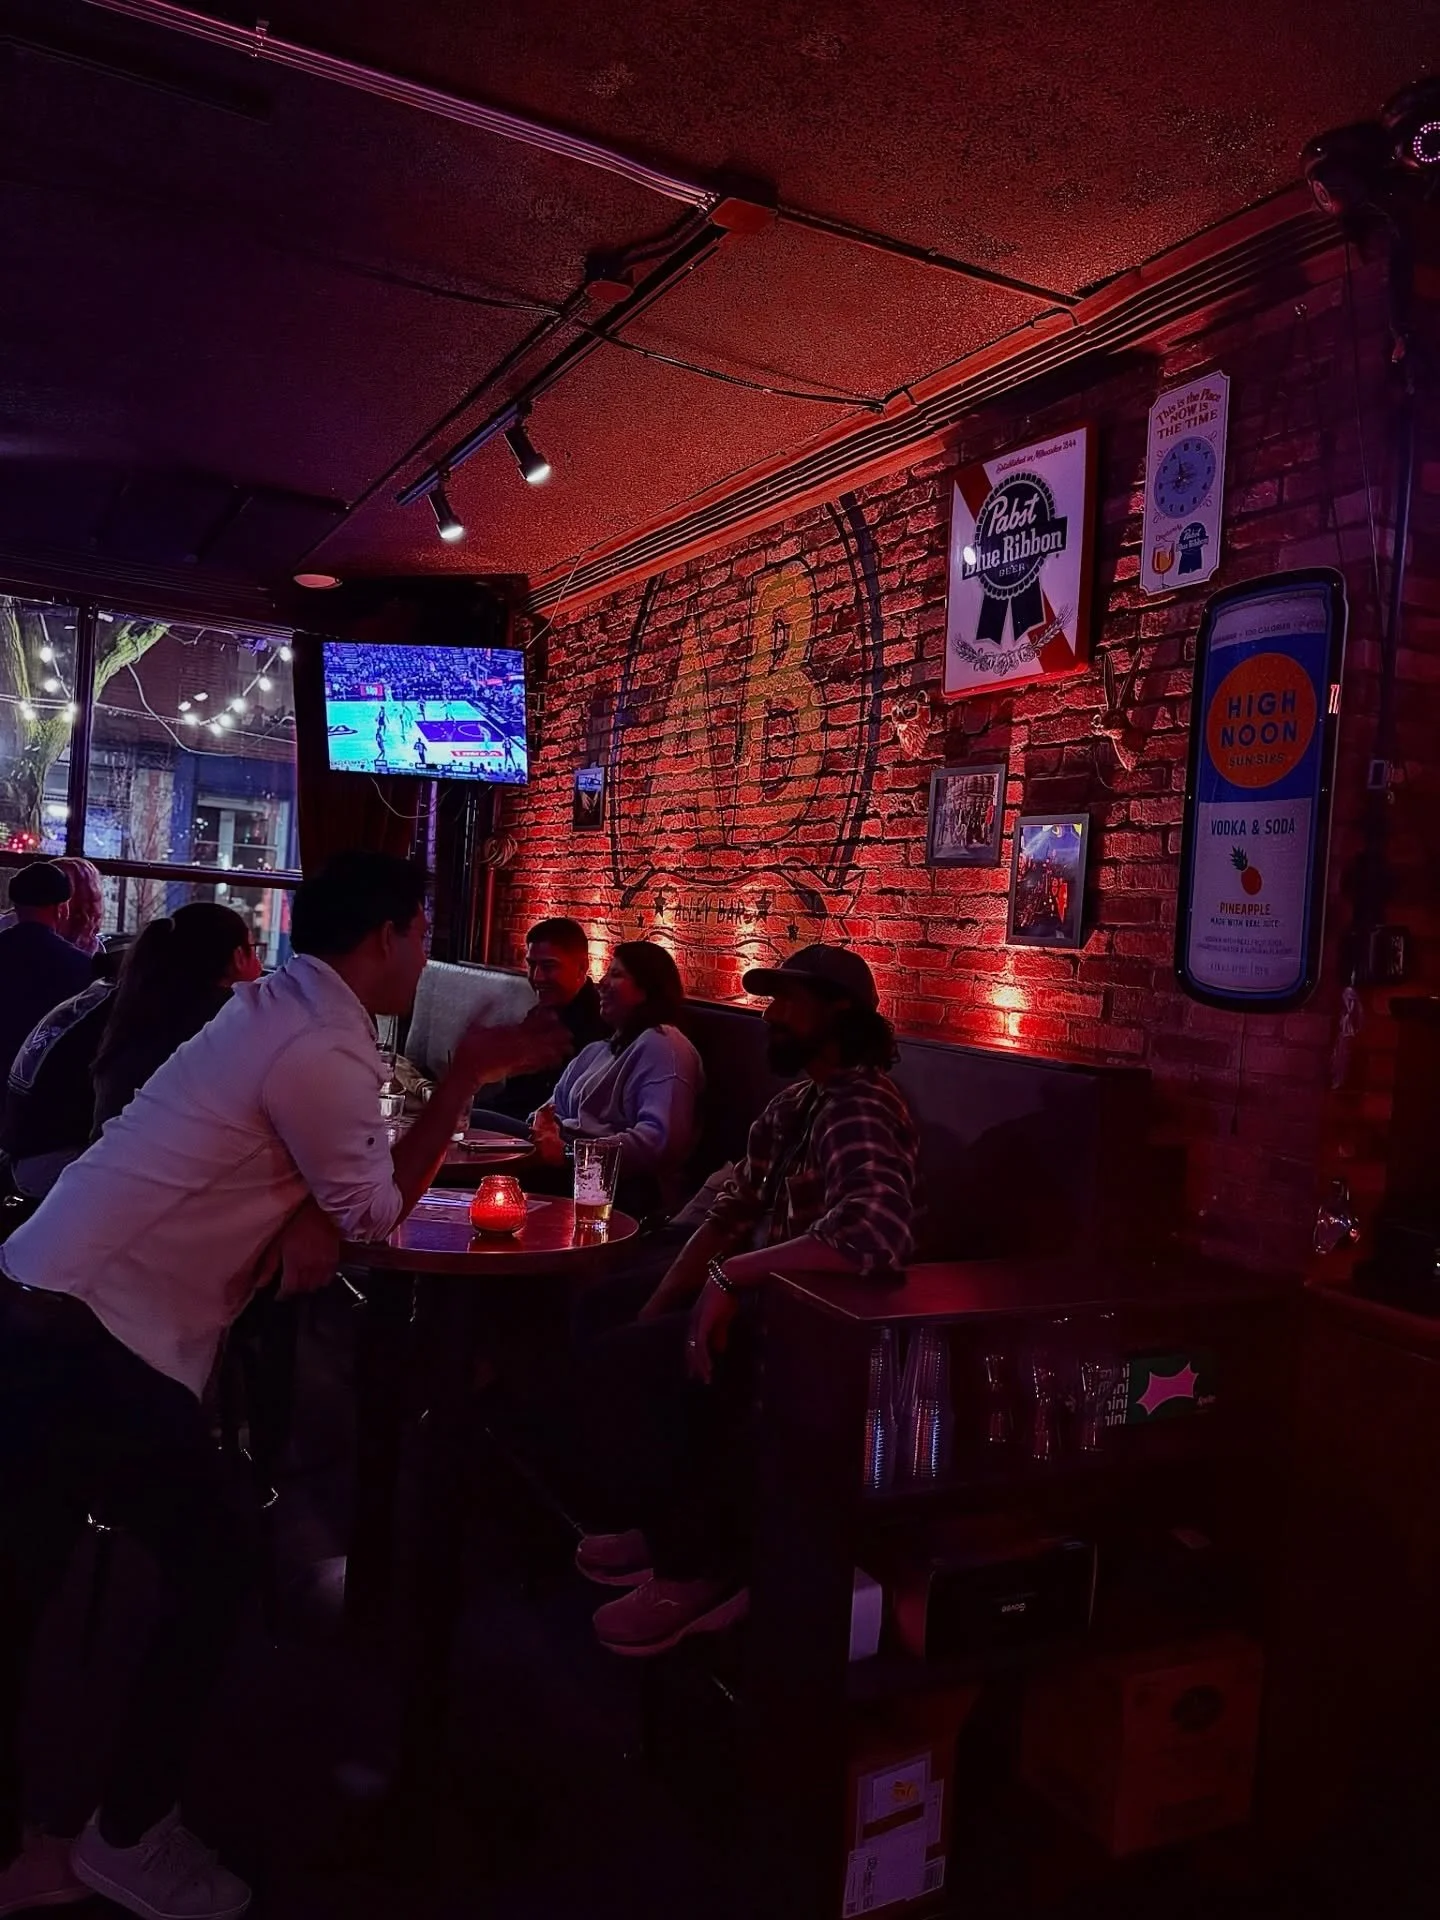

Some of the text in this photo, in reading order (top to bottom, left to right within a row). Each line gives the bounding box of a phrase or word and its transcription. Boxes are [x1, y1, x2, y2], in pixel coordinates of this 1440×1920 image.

[1156, 405, 1176, 425] This
[1177, 399, 1185, 409] is
[1187, 391, 1200, 404] the
[1170, 402, 1208, 423] NOW IS
[1157, 409, 1218, 439] THE TIME
[988, 493, 1040, 537] Pabst
[1002, 528, 1063, 563] Ribbon
[999, 563, 1025, 576] BEER
[1228, 690, 1296, 719] HIGH
[1221, 720, 1297, 747] NOON
[1211, 818, 1295, 835] VODKA & SODA
[1219, 902, 1271, 916] PINEAPPLE
